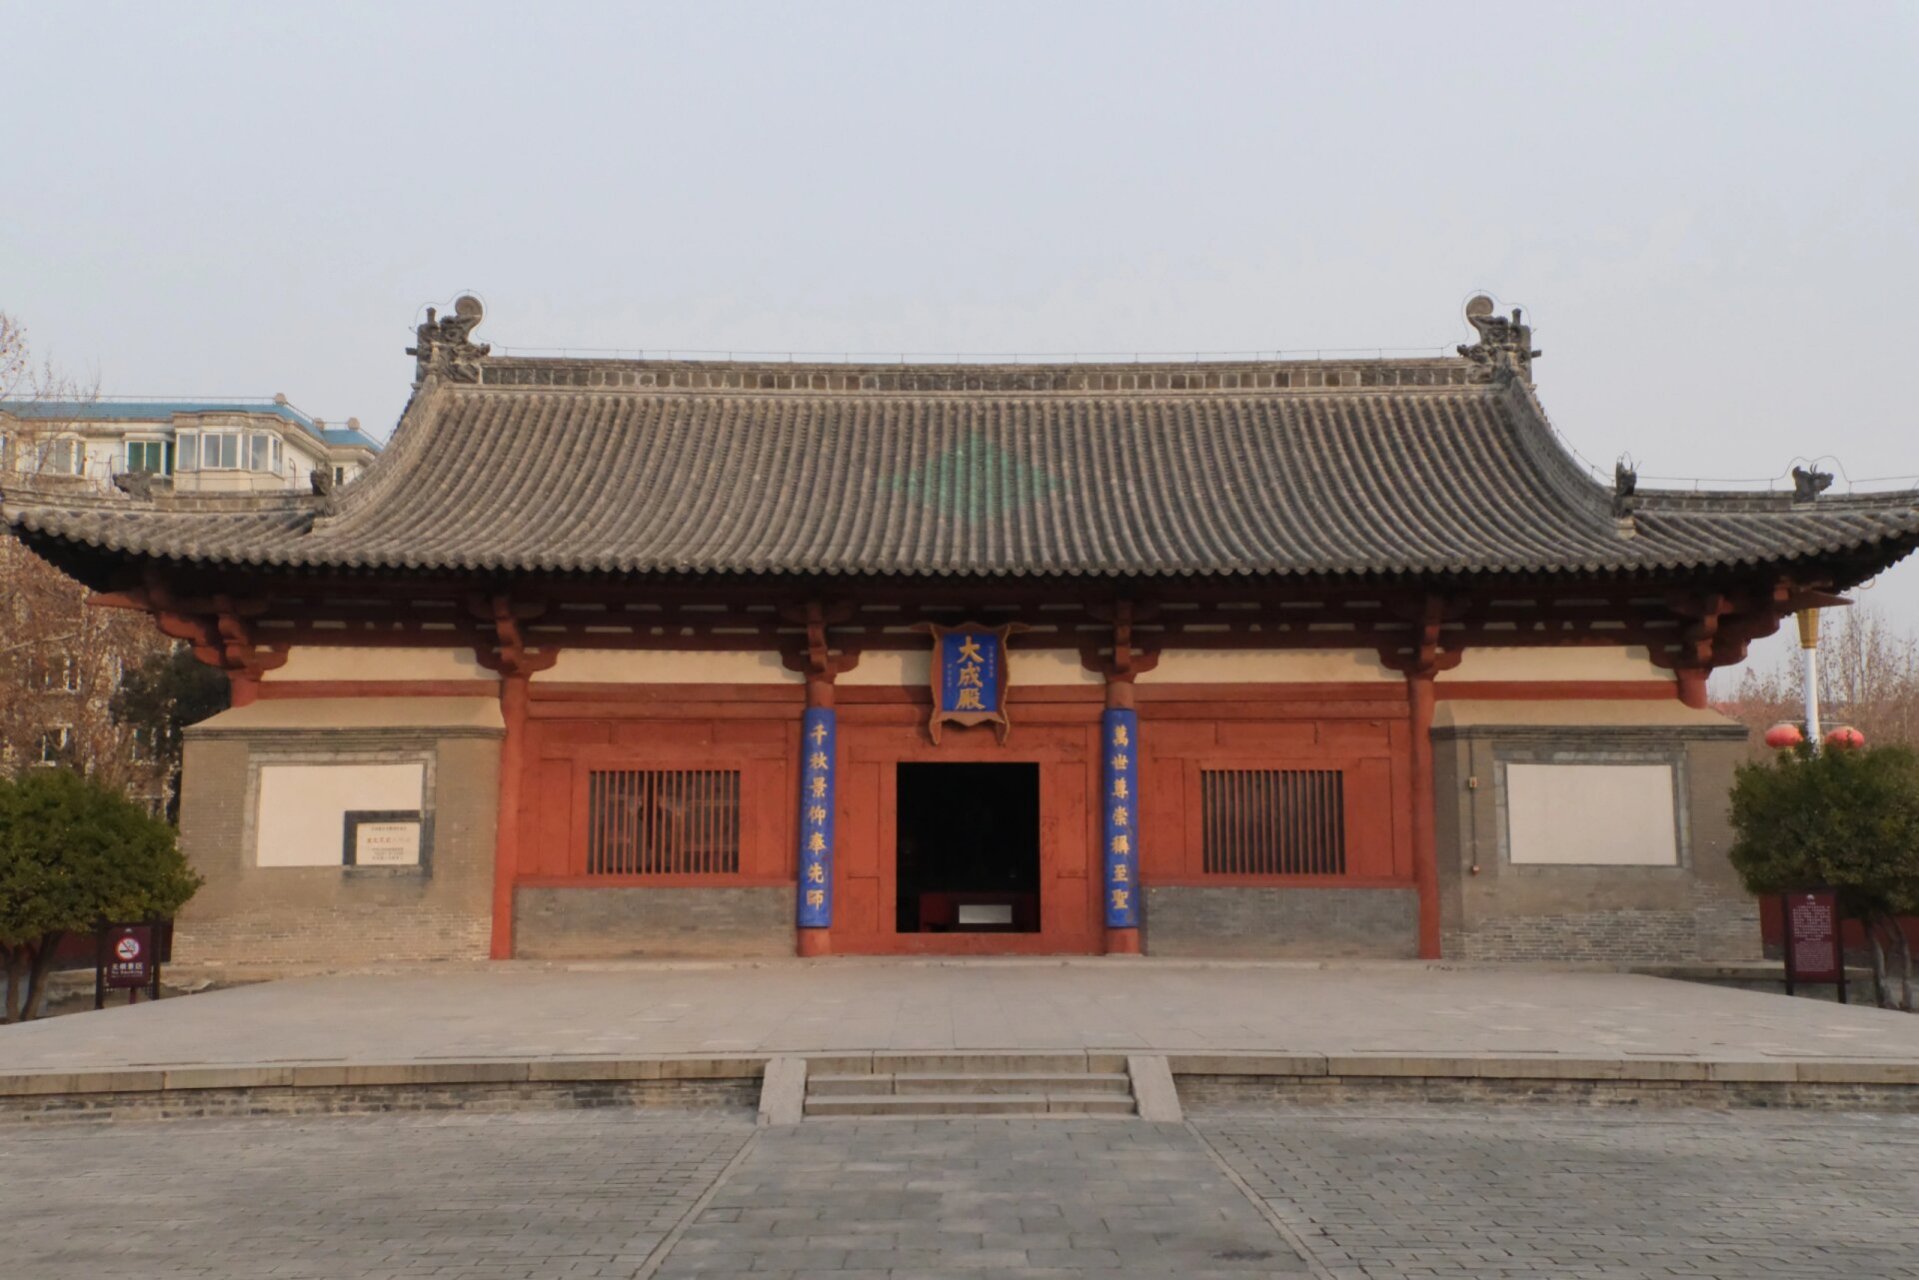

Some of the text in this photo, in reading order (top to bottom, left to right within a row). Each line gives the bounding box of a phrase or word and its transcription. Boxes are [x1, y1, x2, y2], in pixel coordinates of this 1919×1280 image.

[955, 635, 986, 710] 大成殿
[806, 724, 829, 911] 千秋景仰奉先師
